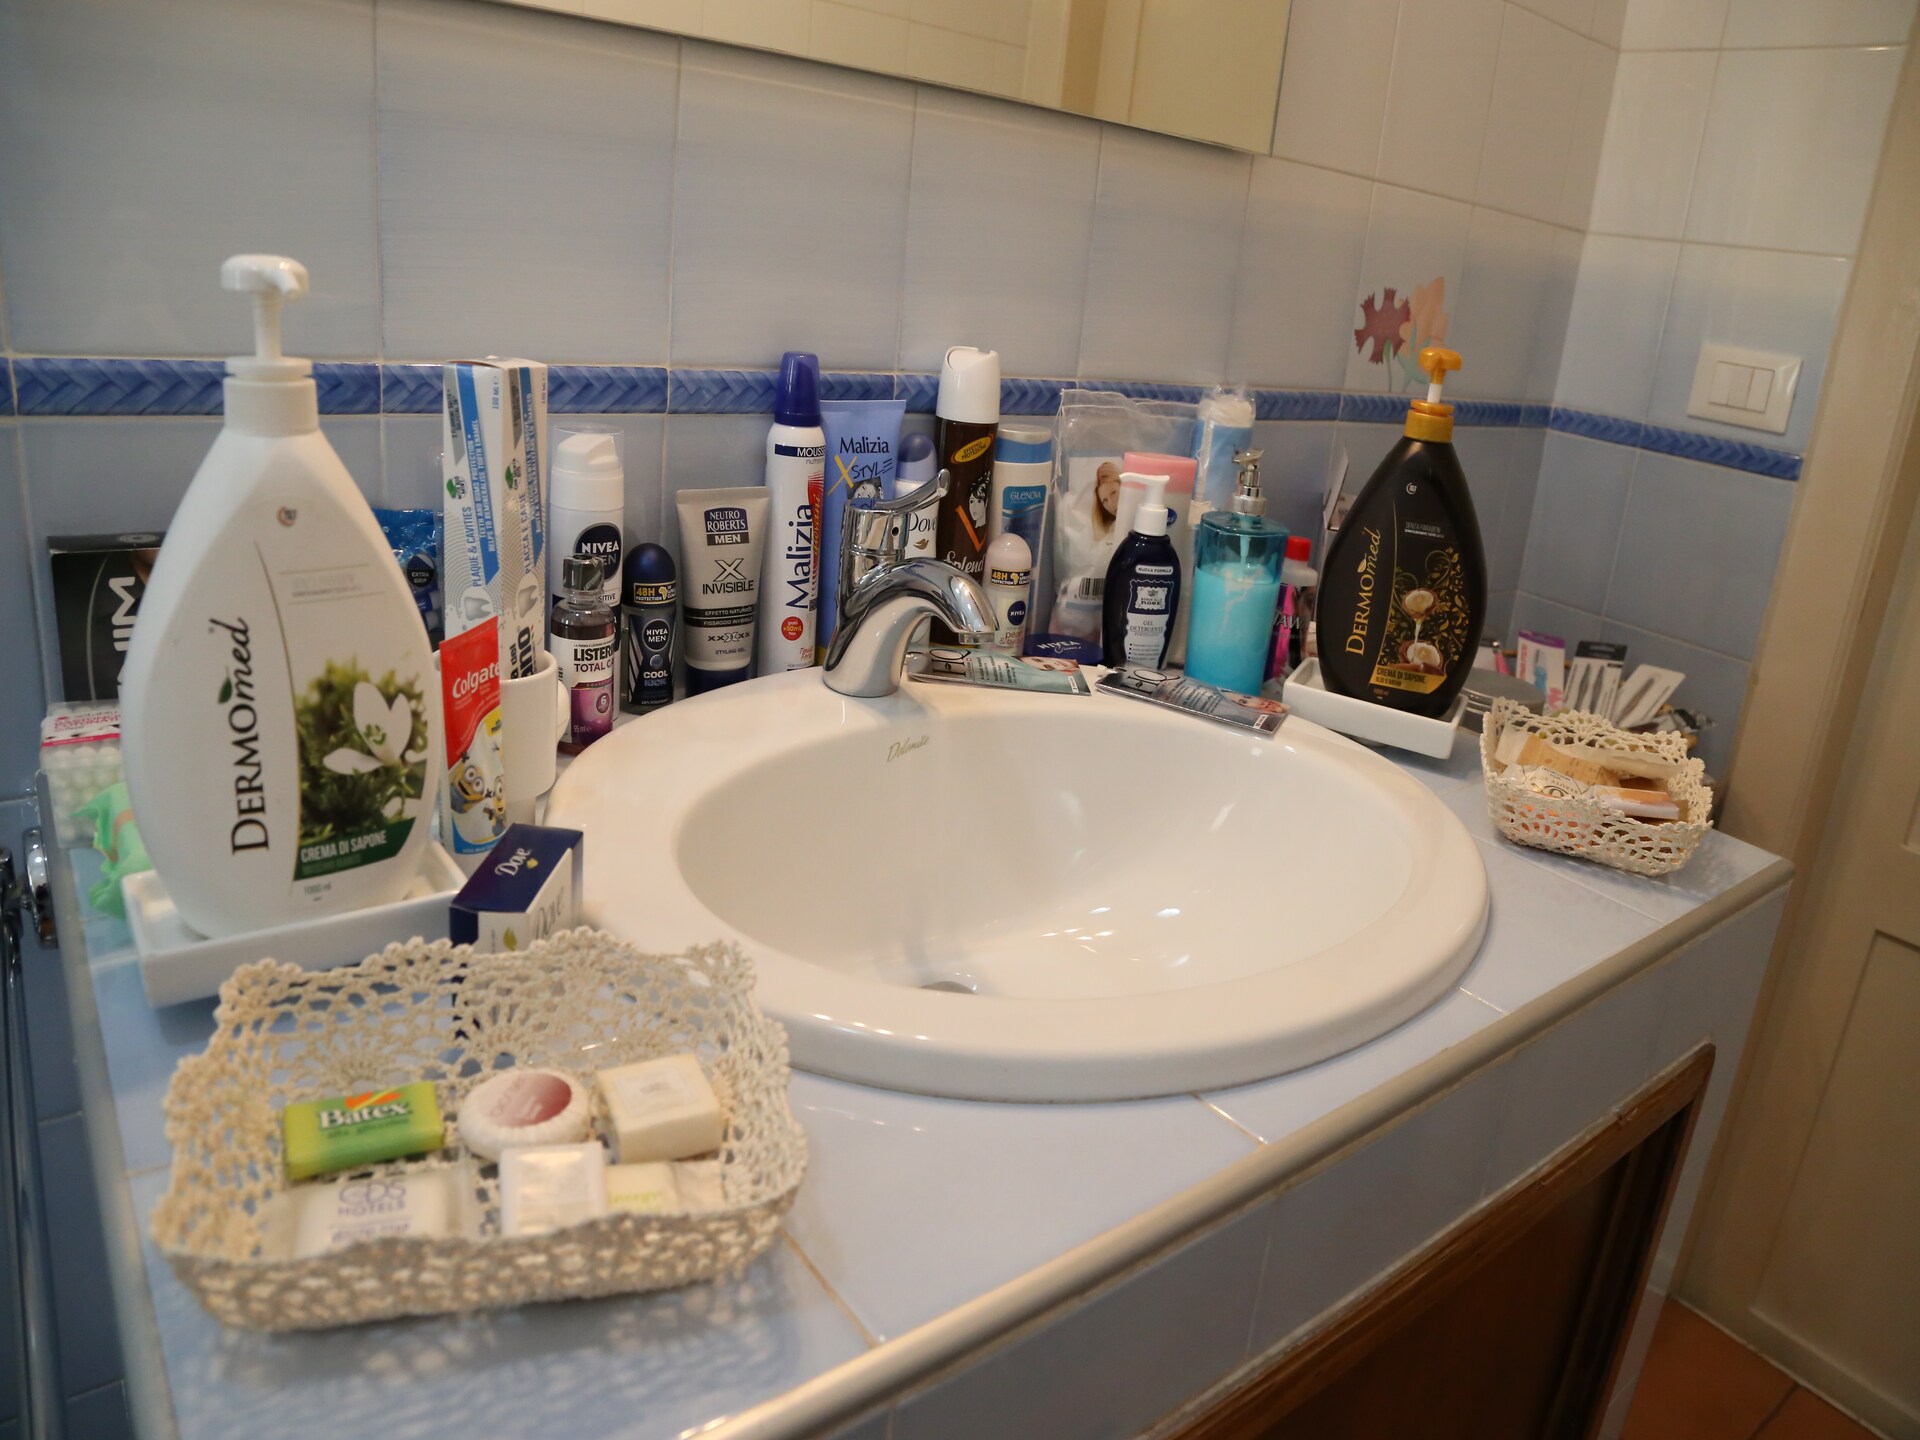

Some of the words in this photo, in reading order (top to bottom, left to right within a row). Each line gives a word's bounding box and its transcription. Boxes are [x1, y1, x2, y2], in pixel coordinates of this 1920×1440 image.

[840, 436, 890, 454] Malizia
[467, 440, 480, 481] PROTECTION
[518, 492, 529, 524] CARIE
[710, 510, 741, 521] NEUTRO
[462, 506, 476, 544] CAVITIES
[477, 518, 487, 538] TEETH
[707, 519, 746, 533] ROBERTS
[714, 533, 741, 544] MEN
[468, 545, 478, 553] &
[522, 534, 533, 575] PLACCA
[581, 540, 620, 555] NIVEA
[785, 504, 813, 609] Malizia
[469, 555, 482, 587] PLAQUE
[713, 557, 747, 583] X
[991, 571, 1008, 580] 48H
[636, 587, 656, 597] 48H
[702, 579, 755, 595] INVISIBLE
[646, 628, 668, 636] NIVEA
[1037, 640, 1081, 650] NIVEA
[509, 643, 518, 666] del
[574, 661, 606, 673] TOTAL
[643, 670, 668, 679] COOL
[1376, 667, 1397, 678] CREMA
[1403, 672, 1426, 684] SAPONE
[886, 735, 931, 763] Dolomite
[301, 843, 338, 863] CREMA
[338, 840, 350, 856] DI
[350, 829, 388, 853] SAPONE
[494, 847, 532, 877] Dove
[320, 1102, 409, 1130] Batex
[337, 1200, 406, 1217] HOTELS
